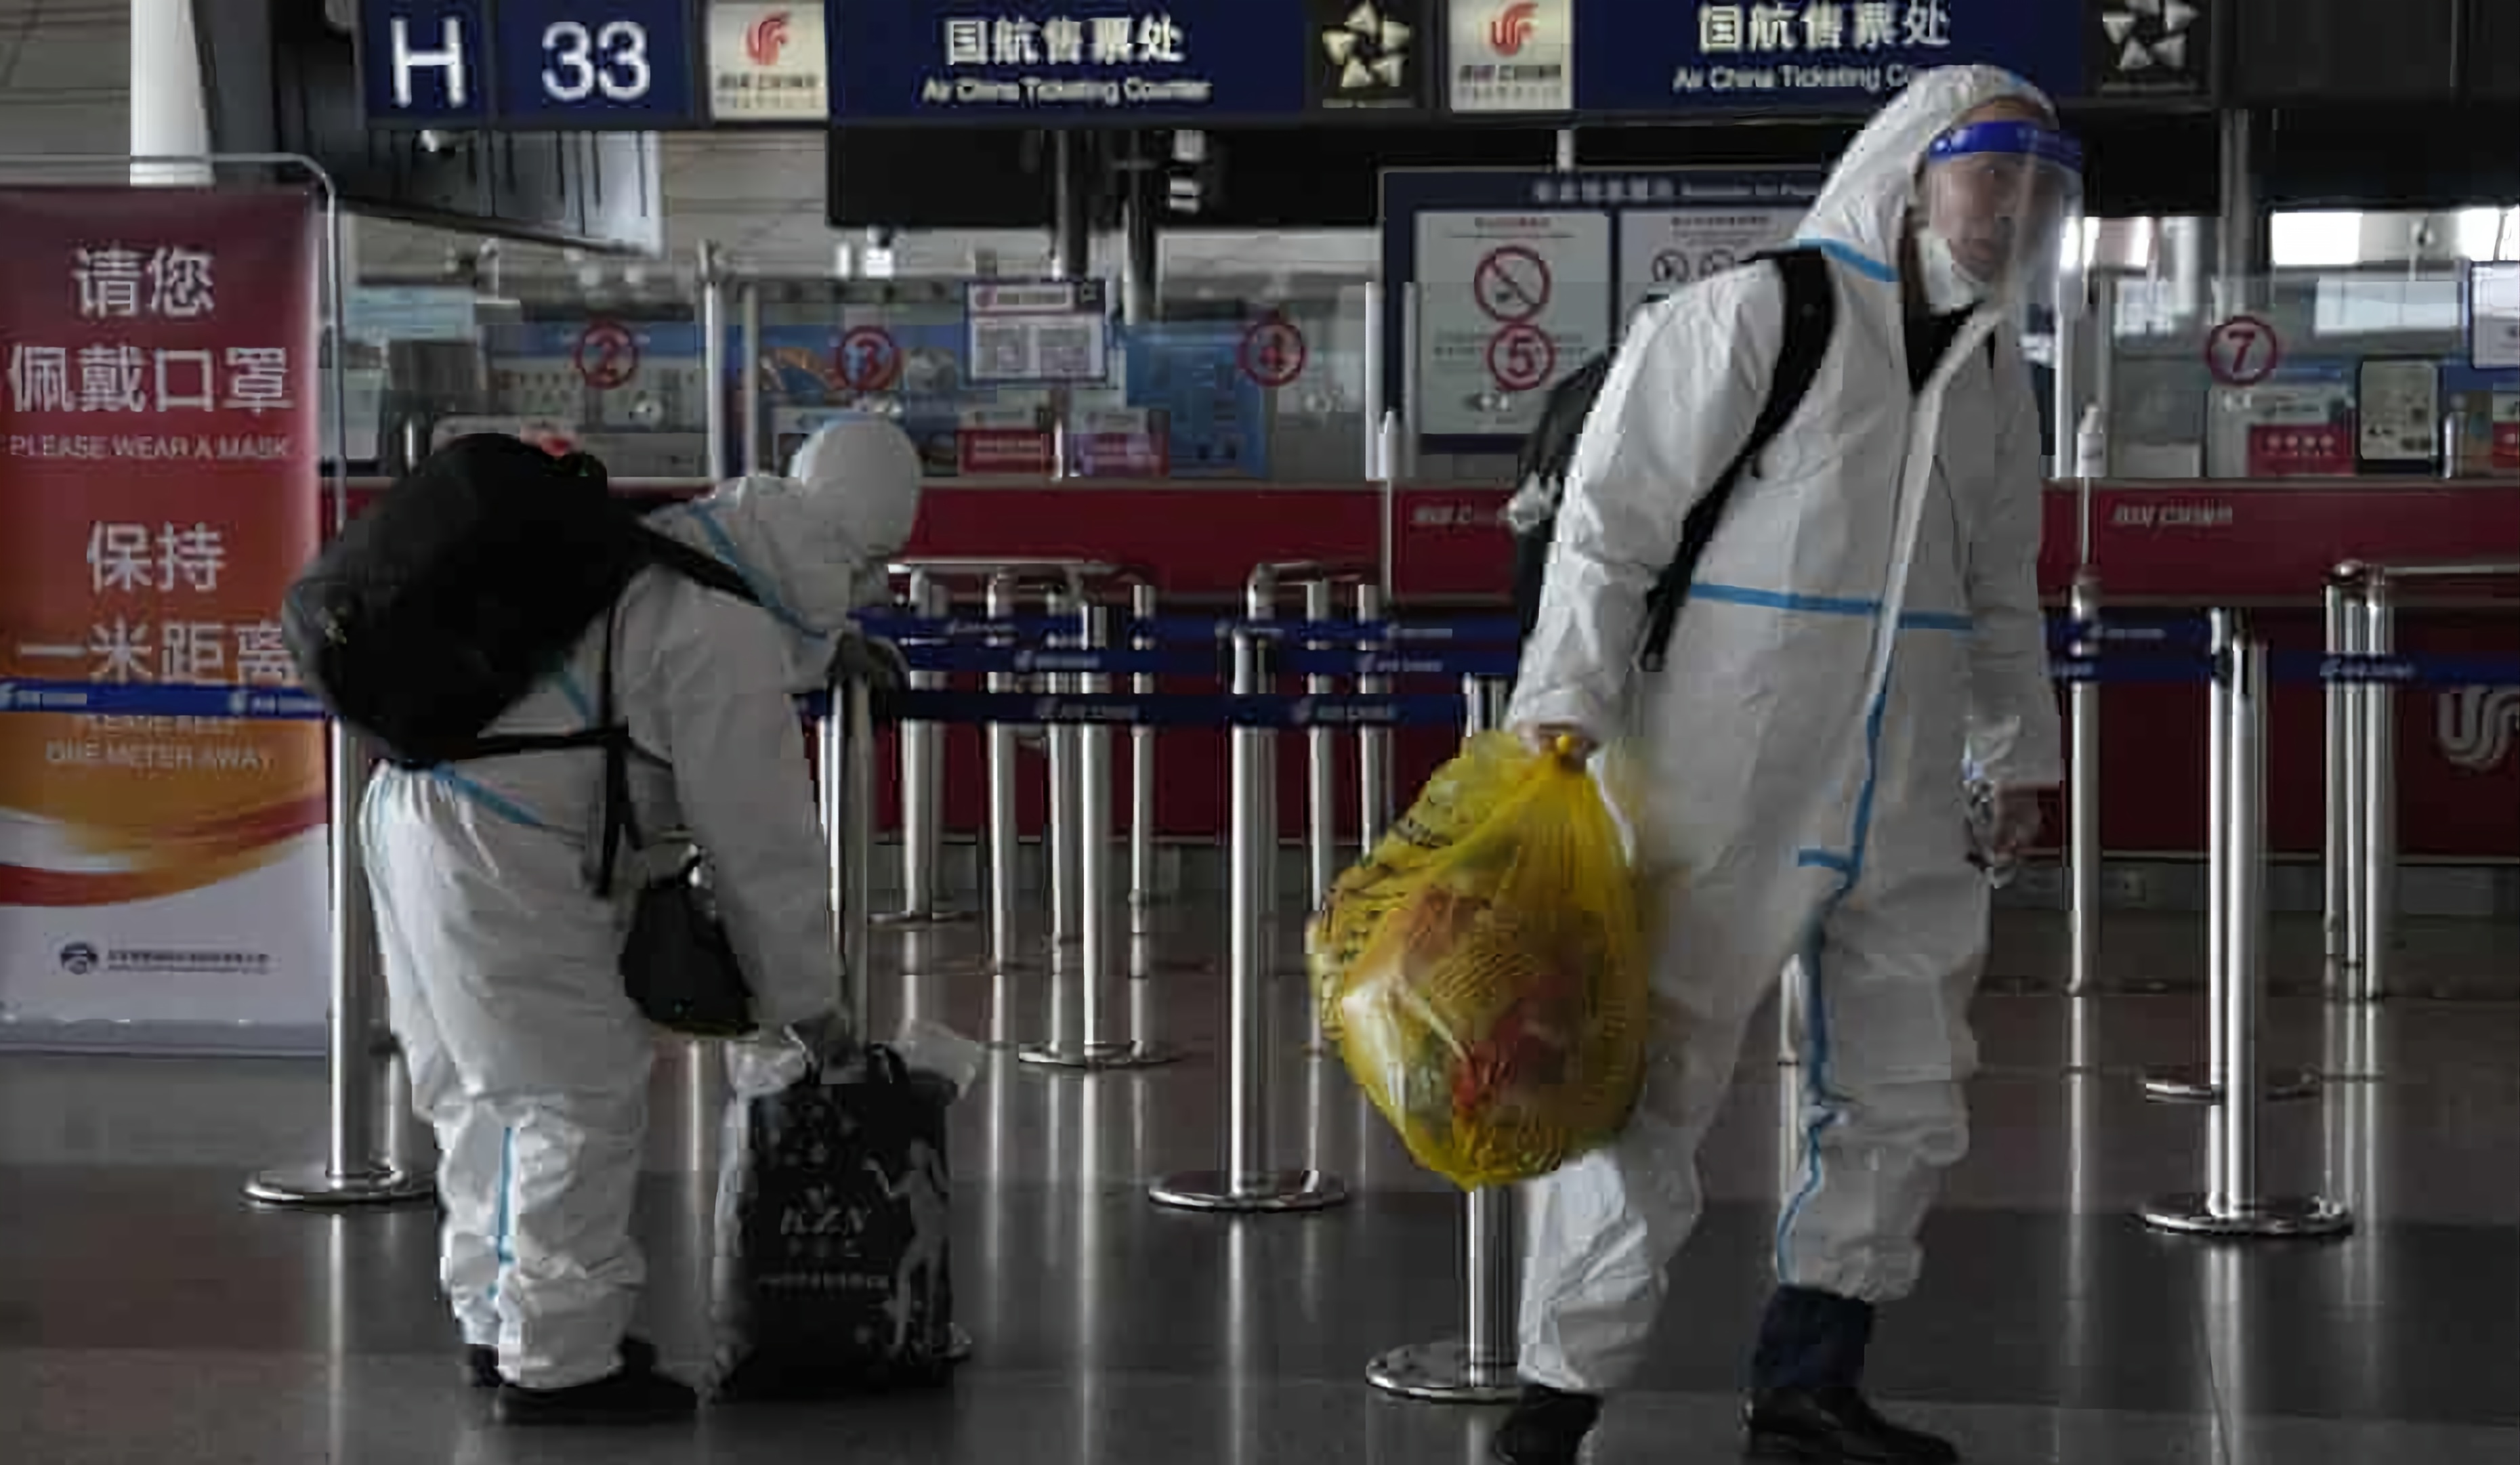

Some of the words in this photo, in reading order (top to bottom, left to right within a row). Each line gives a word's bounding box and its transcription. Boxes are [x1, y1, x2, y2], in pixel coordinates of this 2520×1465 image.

[390, 18, 466, 106] H
[542, 20, 650, 102] 33
[946, 16, 1186, 65] 国航售票处
[1699, 1, 1951, 51] 国航售票处
[71, 242, 215, 319] 请您
[7, 343, 294, 416] 佩戴口罩
[9, 436, 107, 457] PLEASE
[111, 436, 190, 458] WEAR
[216, 437, 287, 460] MASK
[87, 521, 226, 595] 保持
[19, 618, 302, 688] 一米距离
